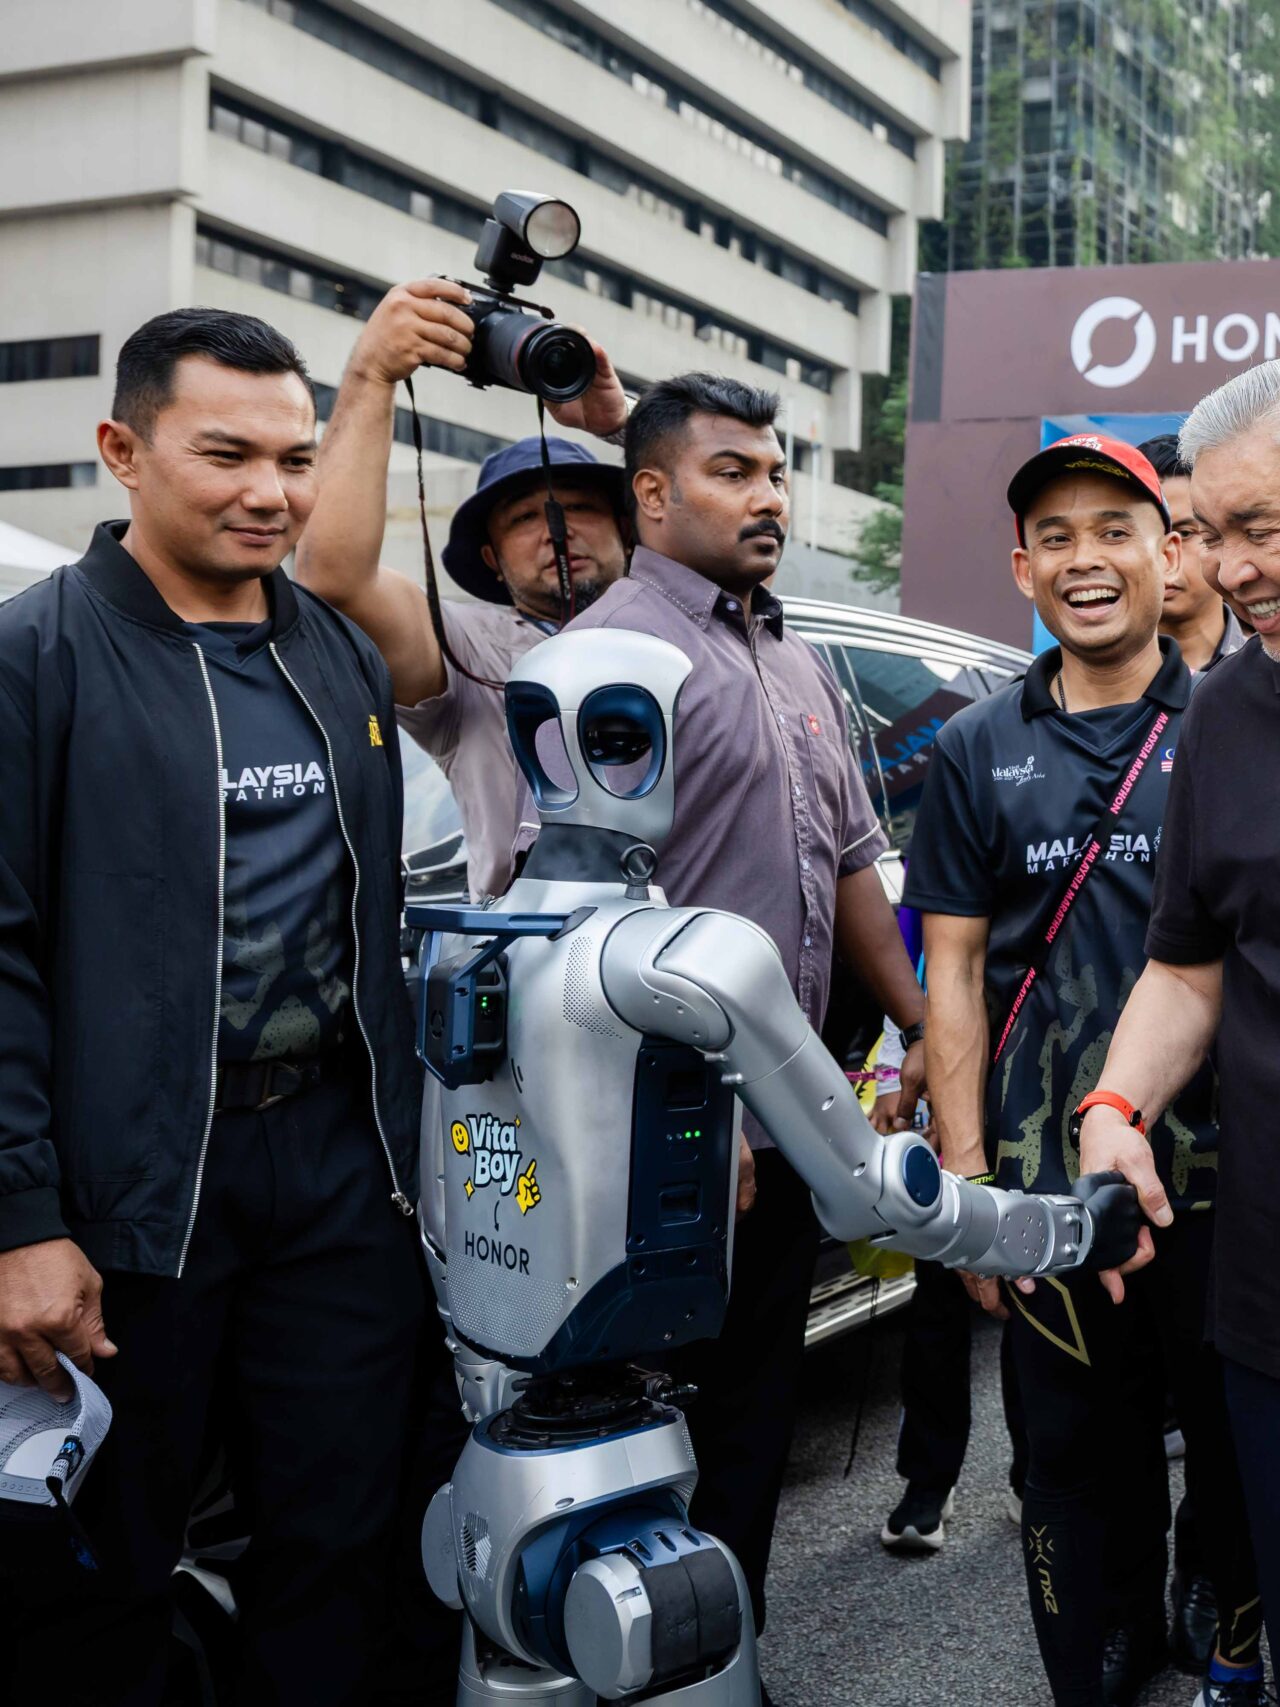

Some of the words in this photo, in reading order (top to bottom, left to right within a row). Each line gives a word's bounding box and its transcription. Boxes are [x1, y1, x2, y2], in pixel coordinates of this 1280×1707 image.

[1139, 712, 1168, 759] MALAYSIA
[222, 761, 326, 789] LAYSIA
[223, 782, 326, 802] RATHON
[1110, 757, 1144, 815] MARATHON
[1026, 833, 1150, 863] MALSIA
[1027, 851, 1150, 874] MARHON
[1070, 841, 1101, 890] MALAYSIA
[1045, 888, 1075, 944] MARATHON
[467, 1114, 517, 1151] Vita
[474, 1150, 521, 1195] Boy
[465, 1230, 530, 1275] HONOR
[1038, 1567, 1059, 1615] 2XU
